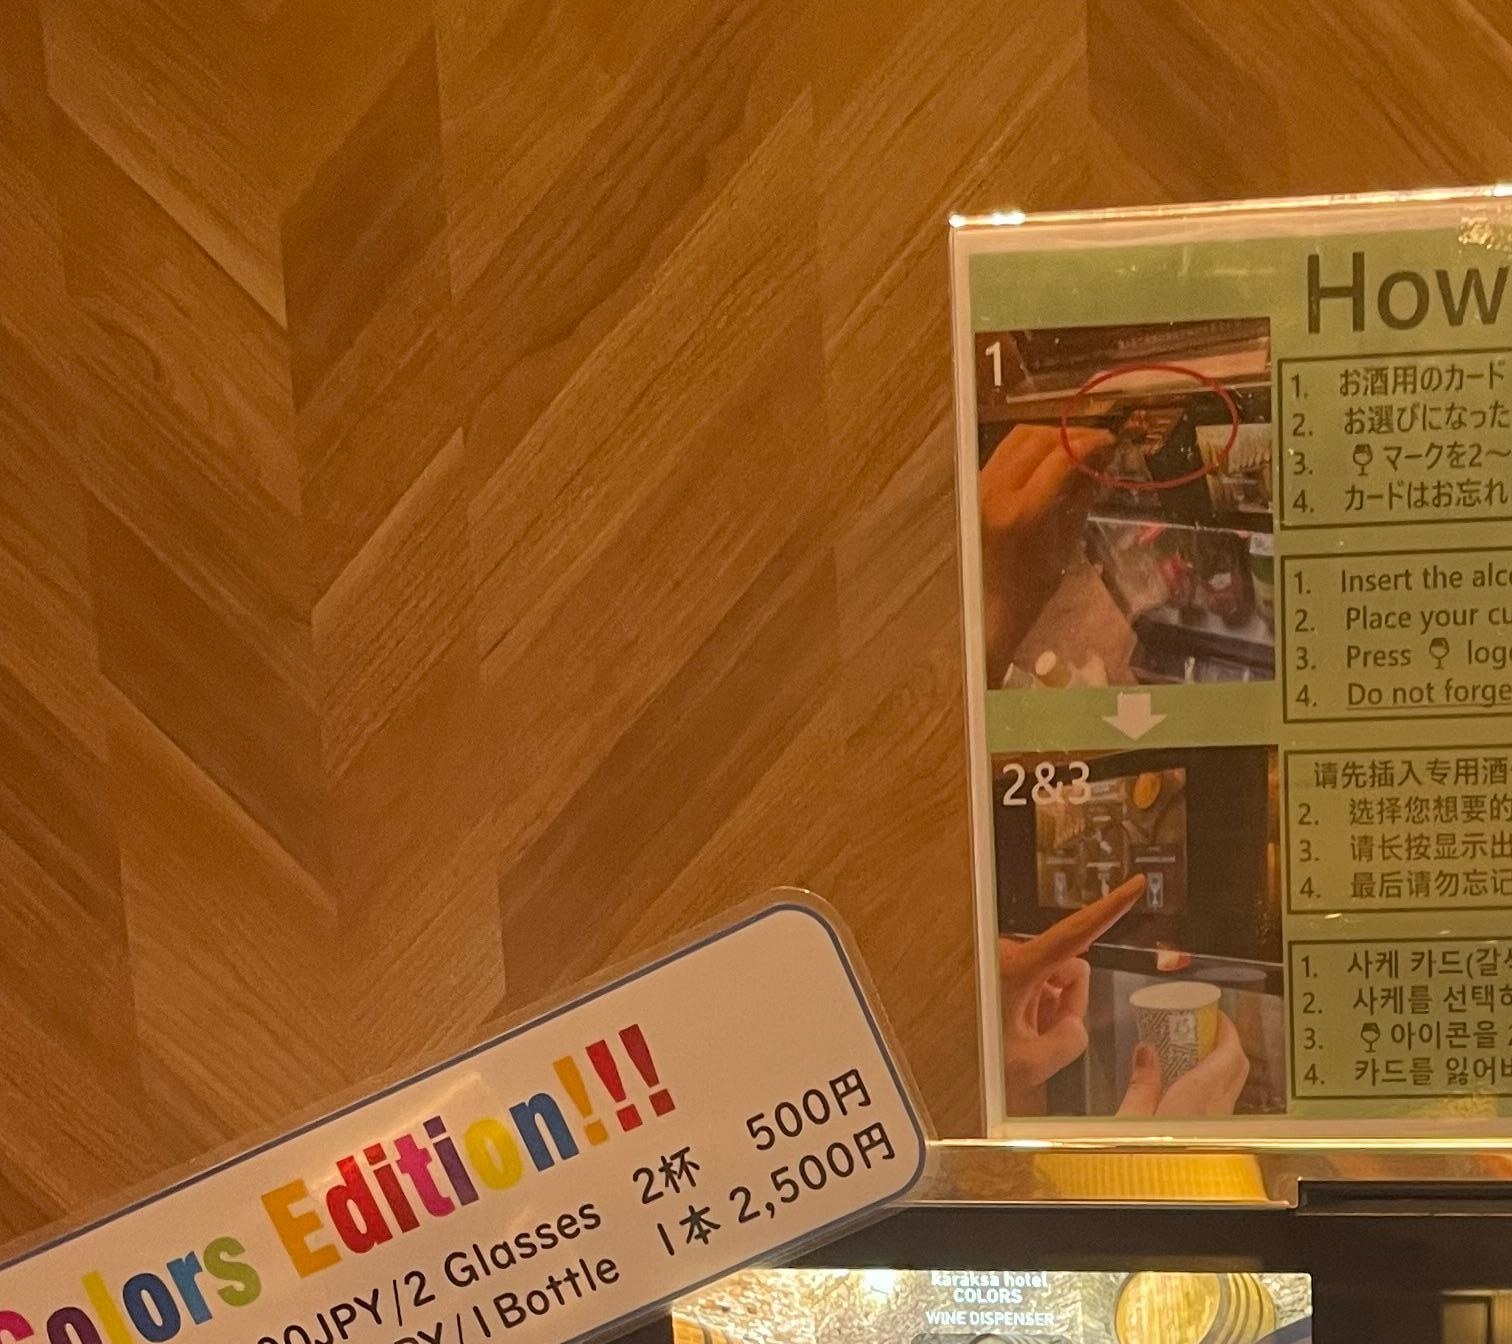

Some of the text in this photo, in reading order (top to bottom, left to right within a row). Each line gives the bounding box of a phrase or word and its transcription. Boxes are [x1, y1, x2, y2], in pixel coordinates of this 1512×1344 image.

[1306, 250, 1509, 335] How
[1341, 569, 1412, 593] Insert
[1423, 566, 1462, 590] the
[1346, 606, 1411, 631] Place
[1420, 608, 1479, 634] your
[1346, 645, 1411, 668] Press
[1348, 682, 1382, 705] Do
[1392, 682, 1434, 704] not
[1002, 760, 1091, 807] 2&3
[1353, 985, 1433, 1016] 사케를
[1391, 1021, 1497, 1051] 아이콘을
[1355, 1058, 1434, 1086] 카드를
[261, 1023, 676, 1279] Edition!!!
[444, 1203, 601, 1288] Glasses
[633, 1146, 701, 1205] 2杯
[747, 1068, 872, 1152] 500円
[729, 1122, 896, 1224] 2,500円
[931, 1271, 1048, 1287] karaksa hotel
[953, 1288, 1022, 1303] COLORS
[926, 1311, 1054, 1325] WINE DISPENSER
